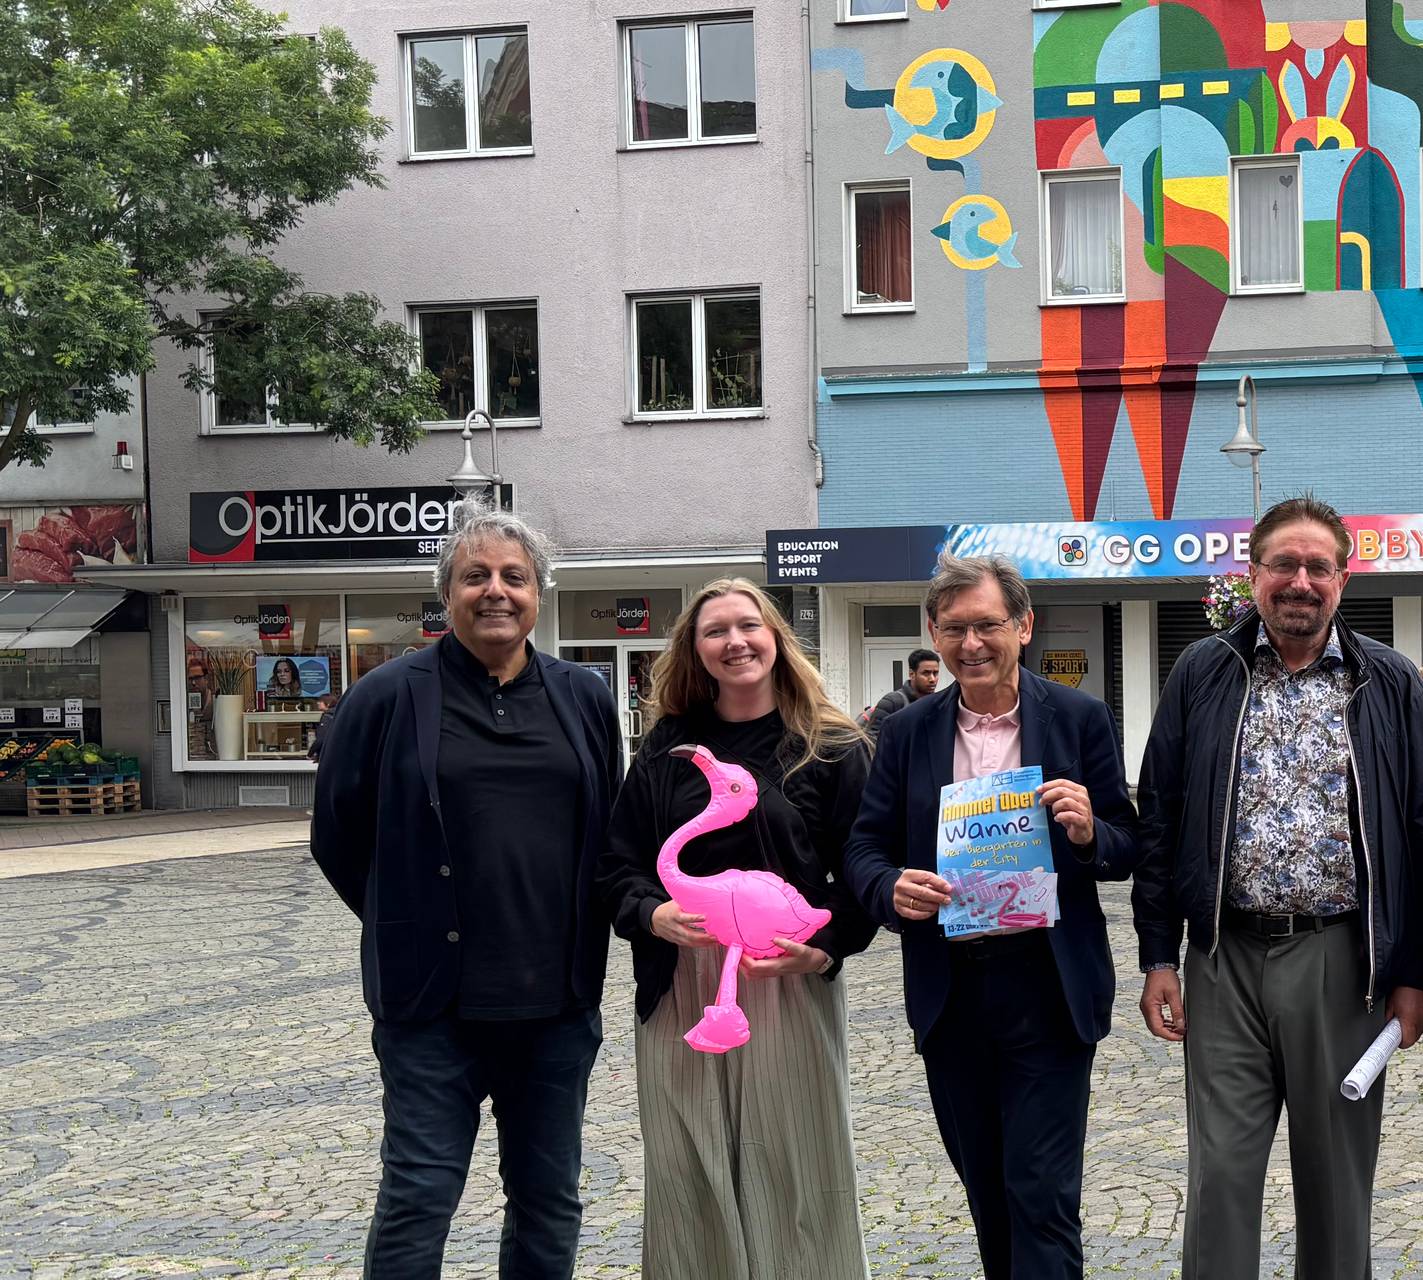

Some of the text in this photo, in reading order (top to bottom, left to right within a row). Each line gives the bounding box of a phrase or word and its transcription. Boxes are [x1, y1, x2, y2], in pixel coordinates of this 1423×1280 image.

[777, 541, 839, 551] EDUCATION
[1102, 534, 1161, 564] GG
[1173, 532, 1249, 563] OPE
[778, 554, 822, 564] E-SPORT
[778, 567, 818, 577] EVENTS
[233, 614, 291, 626] OptikJörden
[590, 608, 650, 620] OptikJörden
[800, 610, 814, 619] 242
[1052, 660, 1087, 673] SPORT
[942, 791, 1035, 823] Himmel über
[945, 815, 1034, 843] Wanne
[965, 840, 1027, 858] Biergarten
[970, 855, 1018, 868] der City
